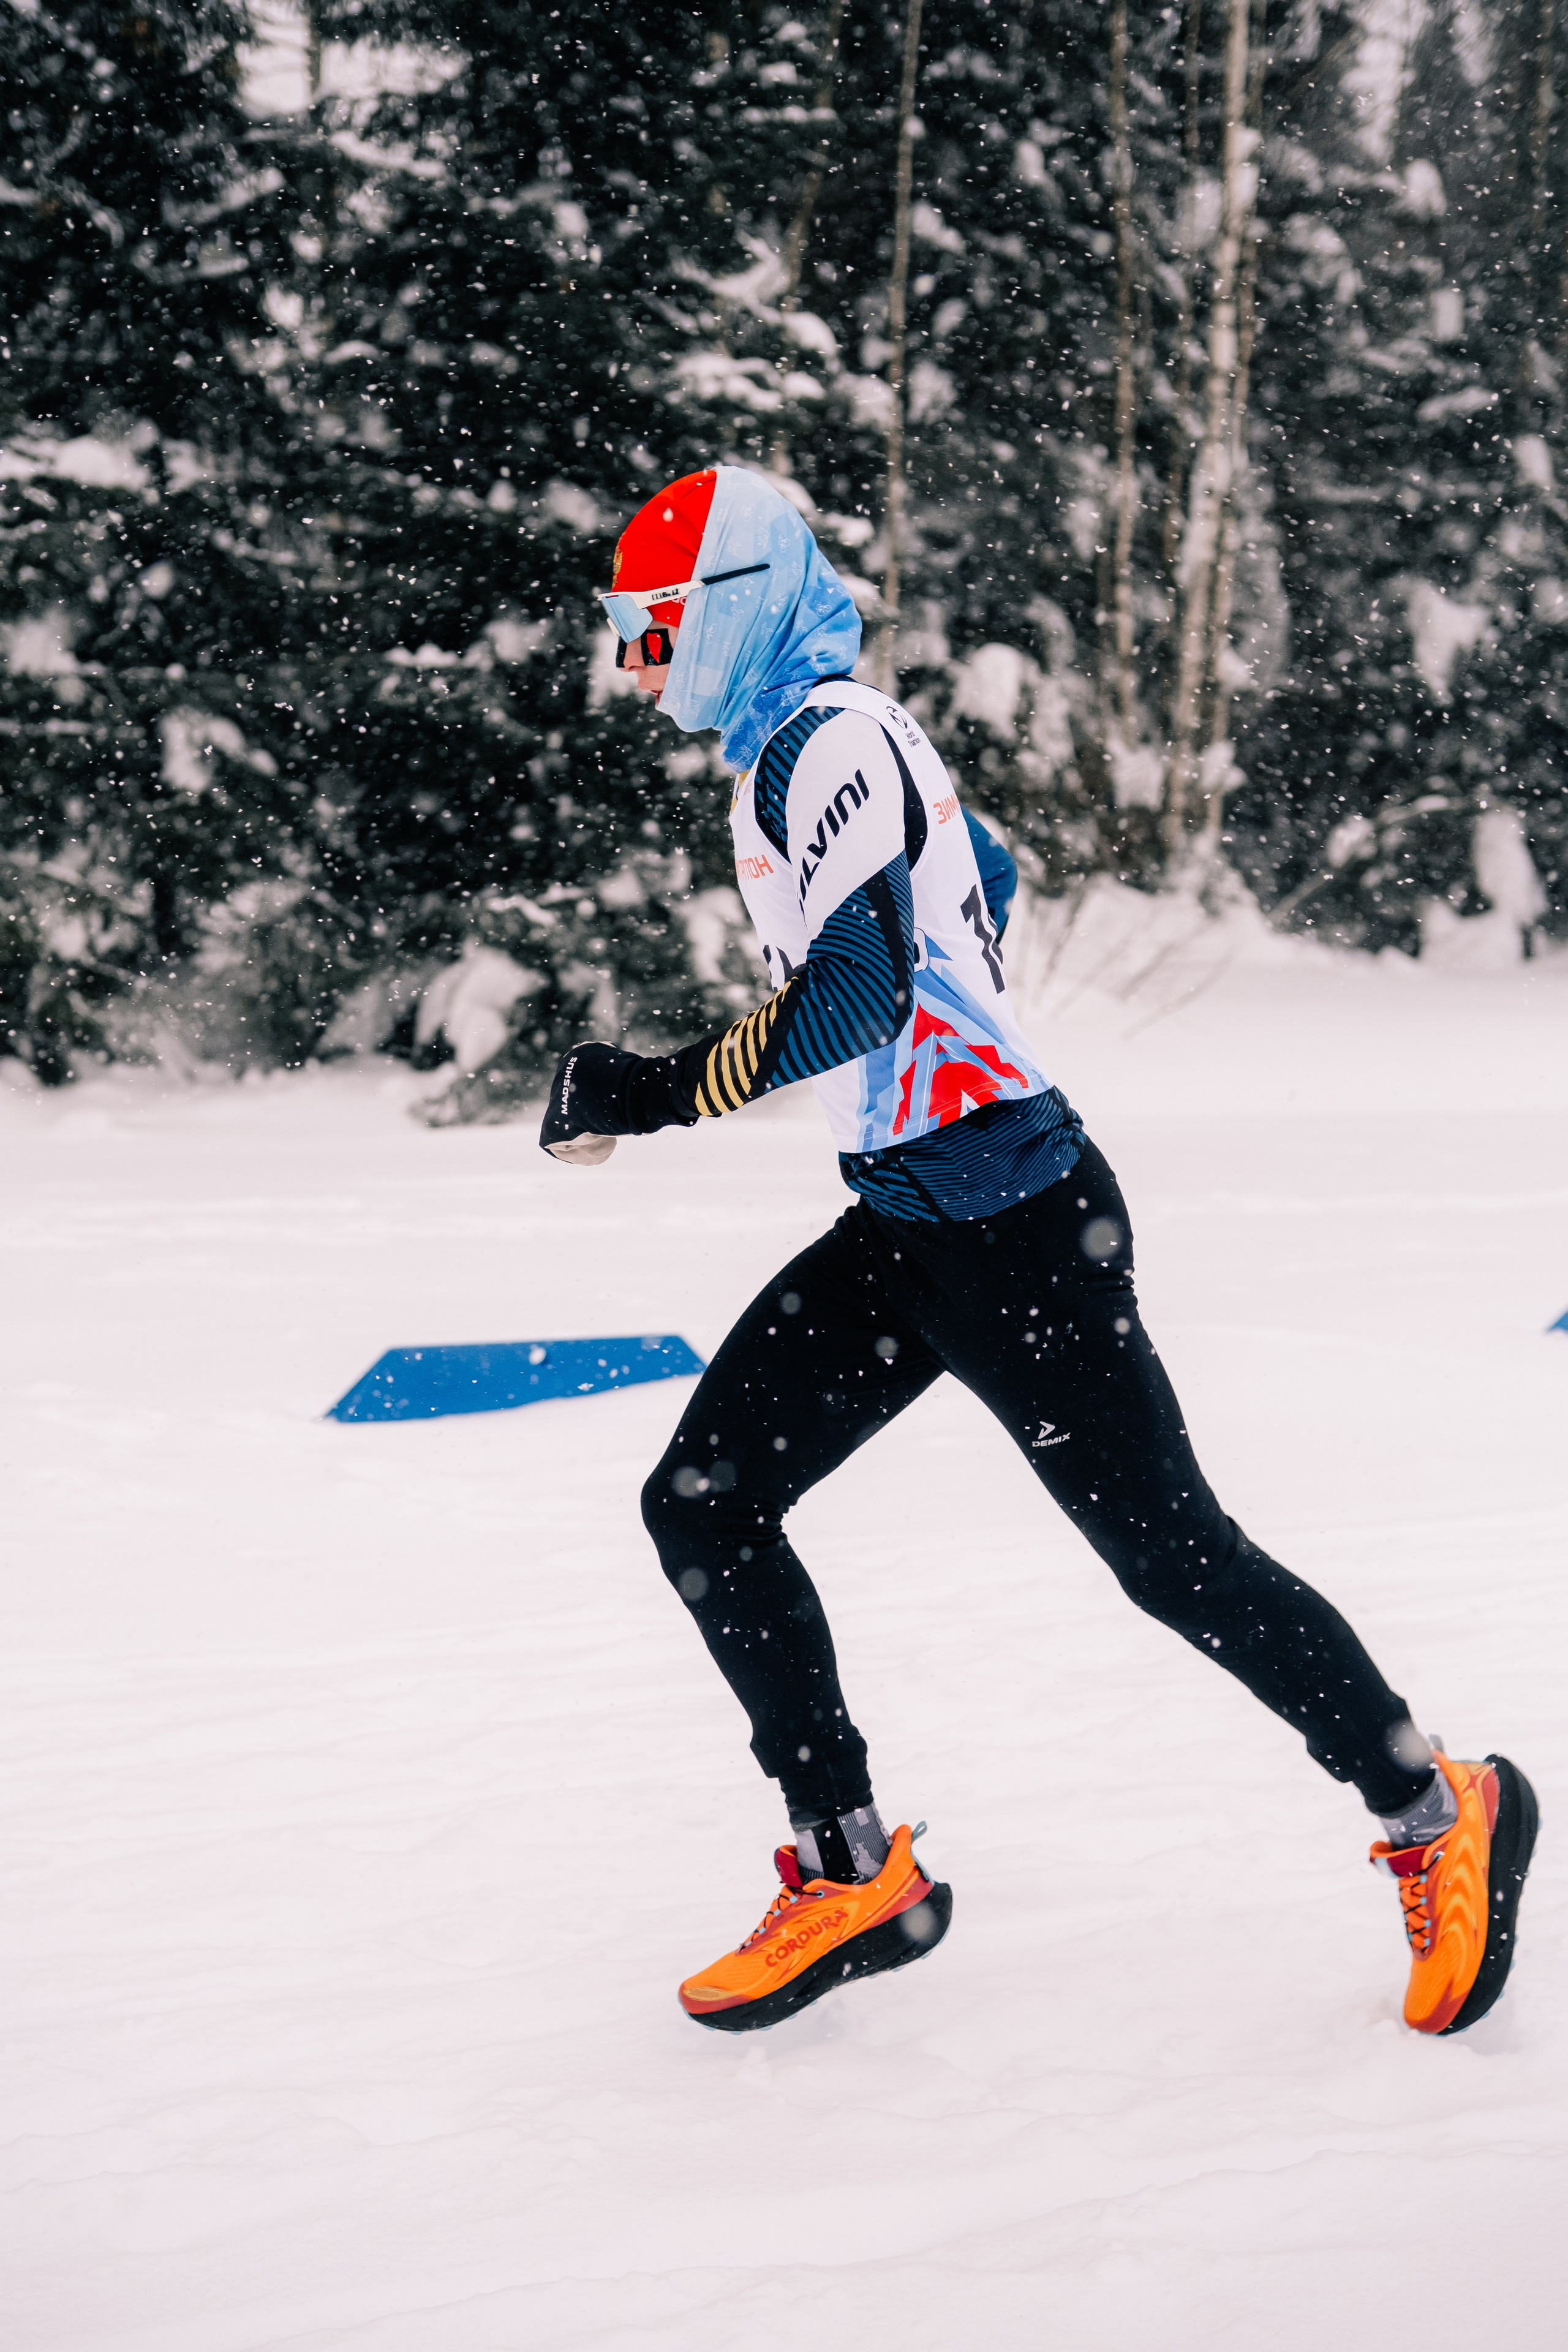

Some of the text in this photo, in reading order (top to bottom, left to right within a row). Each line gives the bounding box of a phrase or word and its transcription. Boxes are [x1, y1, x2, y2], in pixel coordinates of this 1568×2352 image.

[960, 884, 1005, 994] 1
[561, 1057, 578, 1115] MADSHUS
[1032, 1432, 1071, 1447] DEMIX
[765, 1909, 849, 1967] CORDURA
